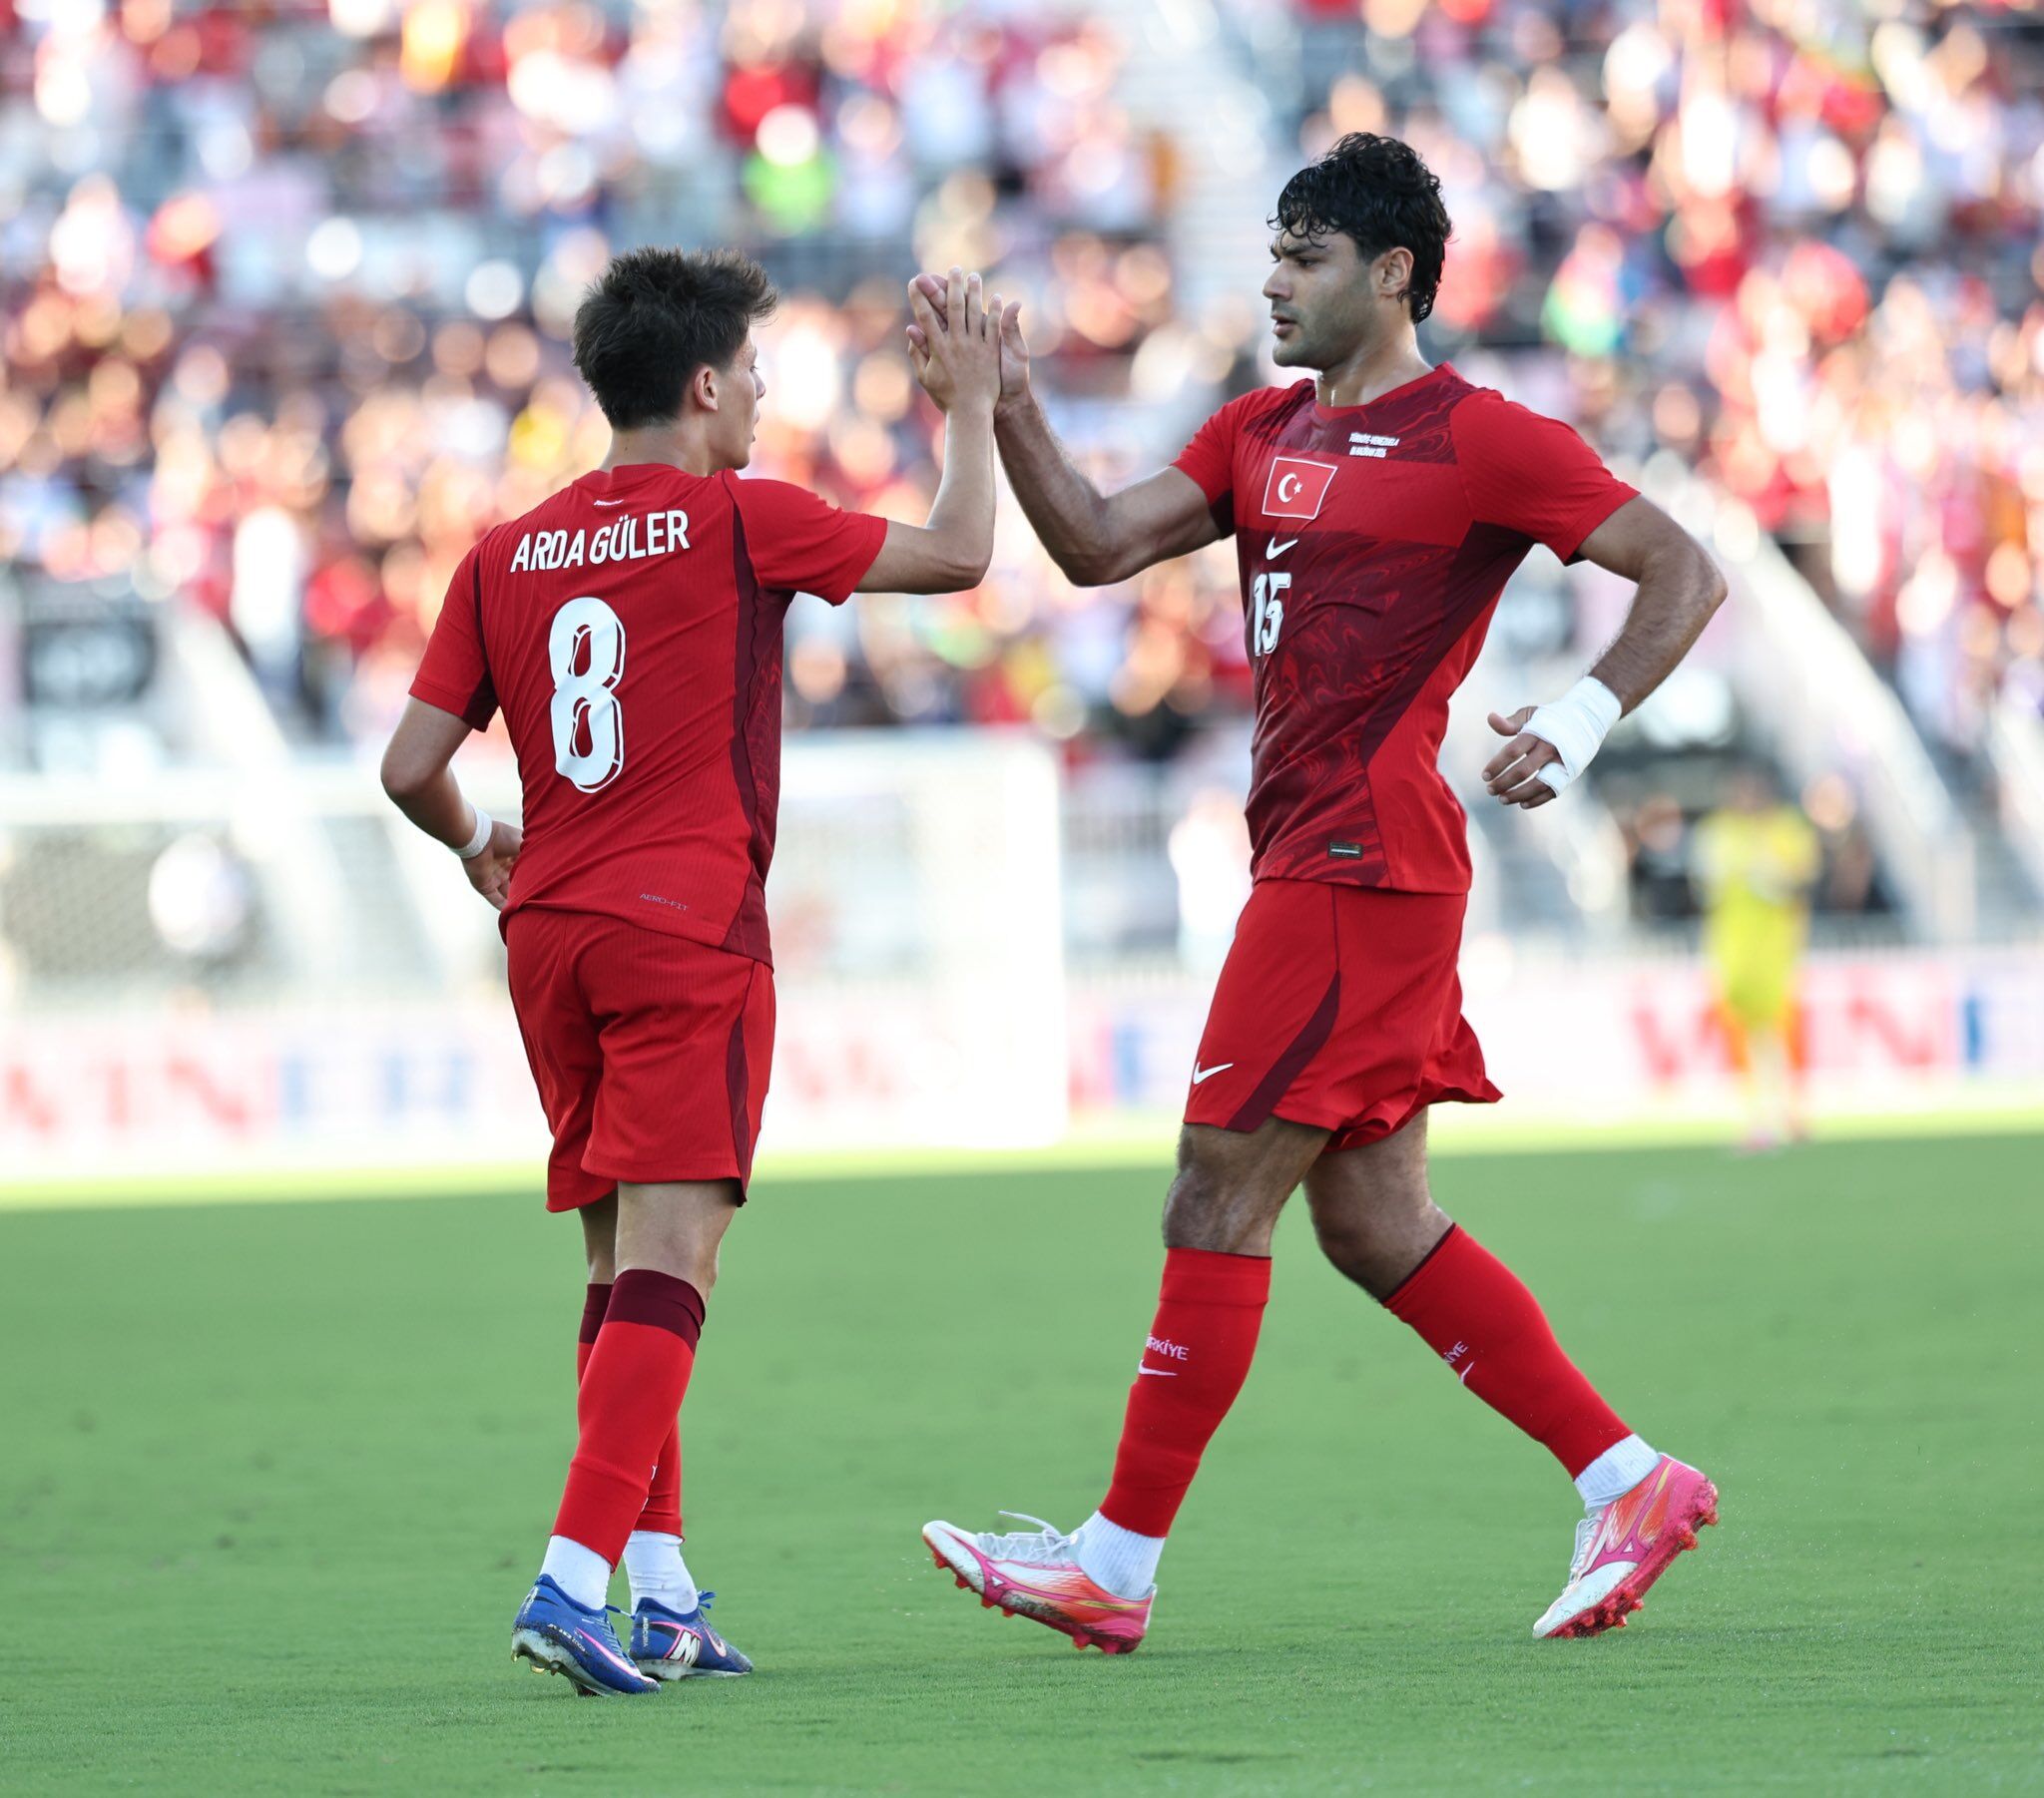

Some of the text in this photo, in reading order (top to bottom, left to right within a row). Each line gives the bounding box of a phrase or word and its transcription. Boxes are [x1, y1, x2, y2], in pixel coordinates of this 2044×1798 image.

[510, 509, 691, 573] ARDA GÜLER
[1254, 572, 1292, 658] 15
[548, 597, 626, 794] 8
